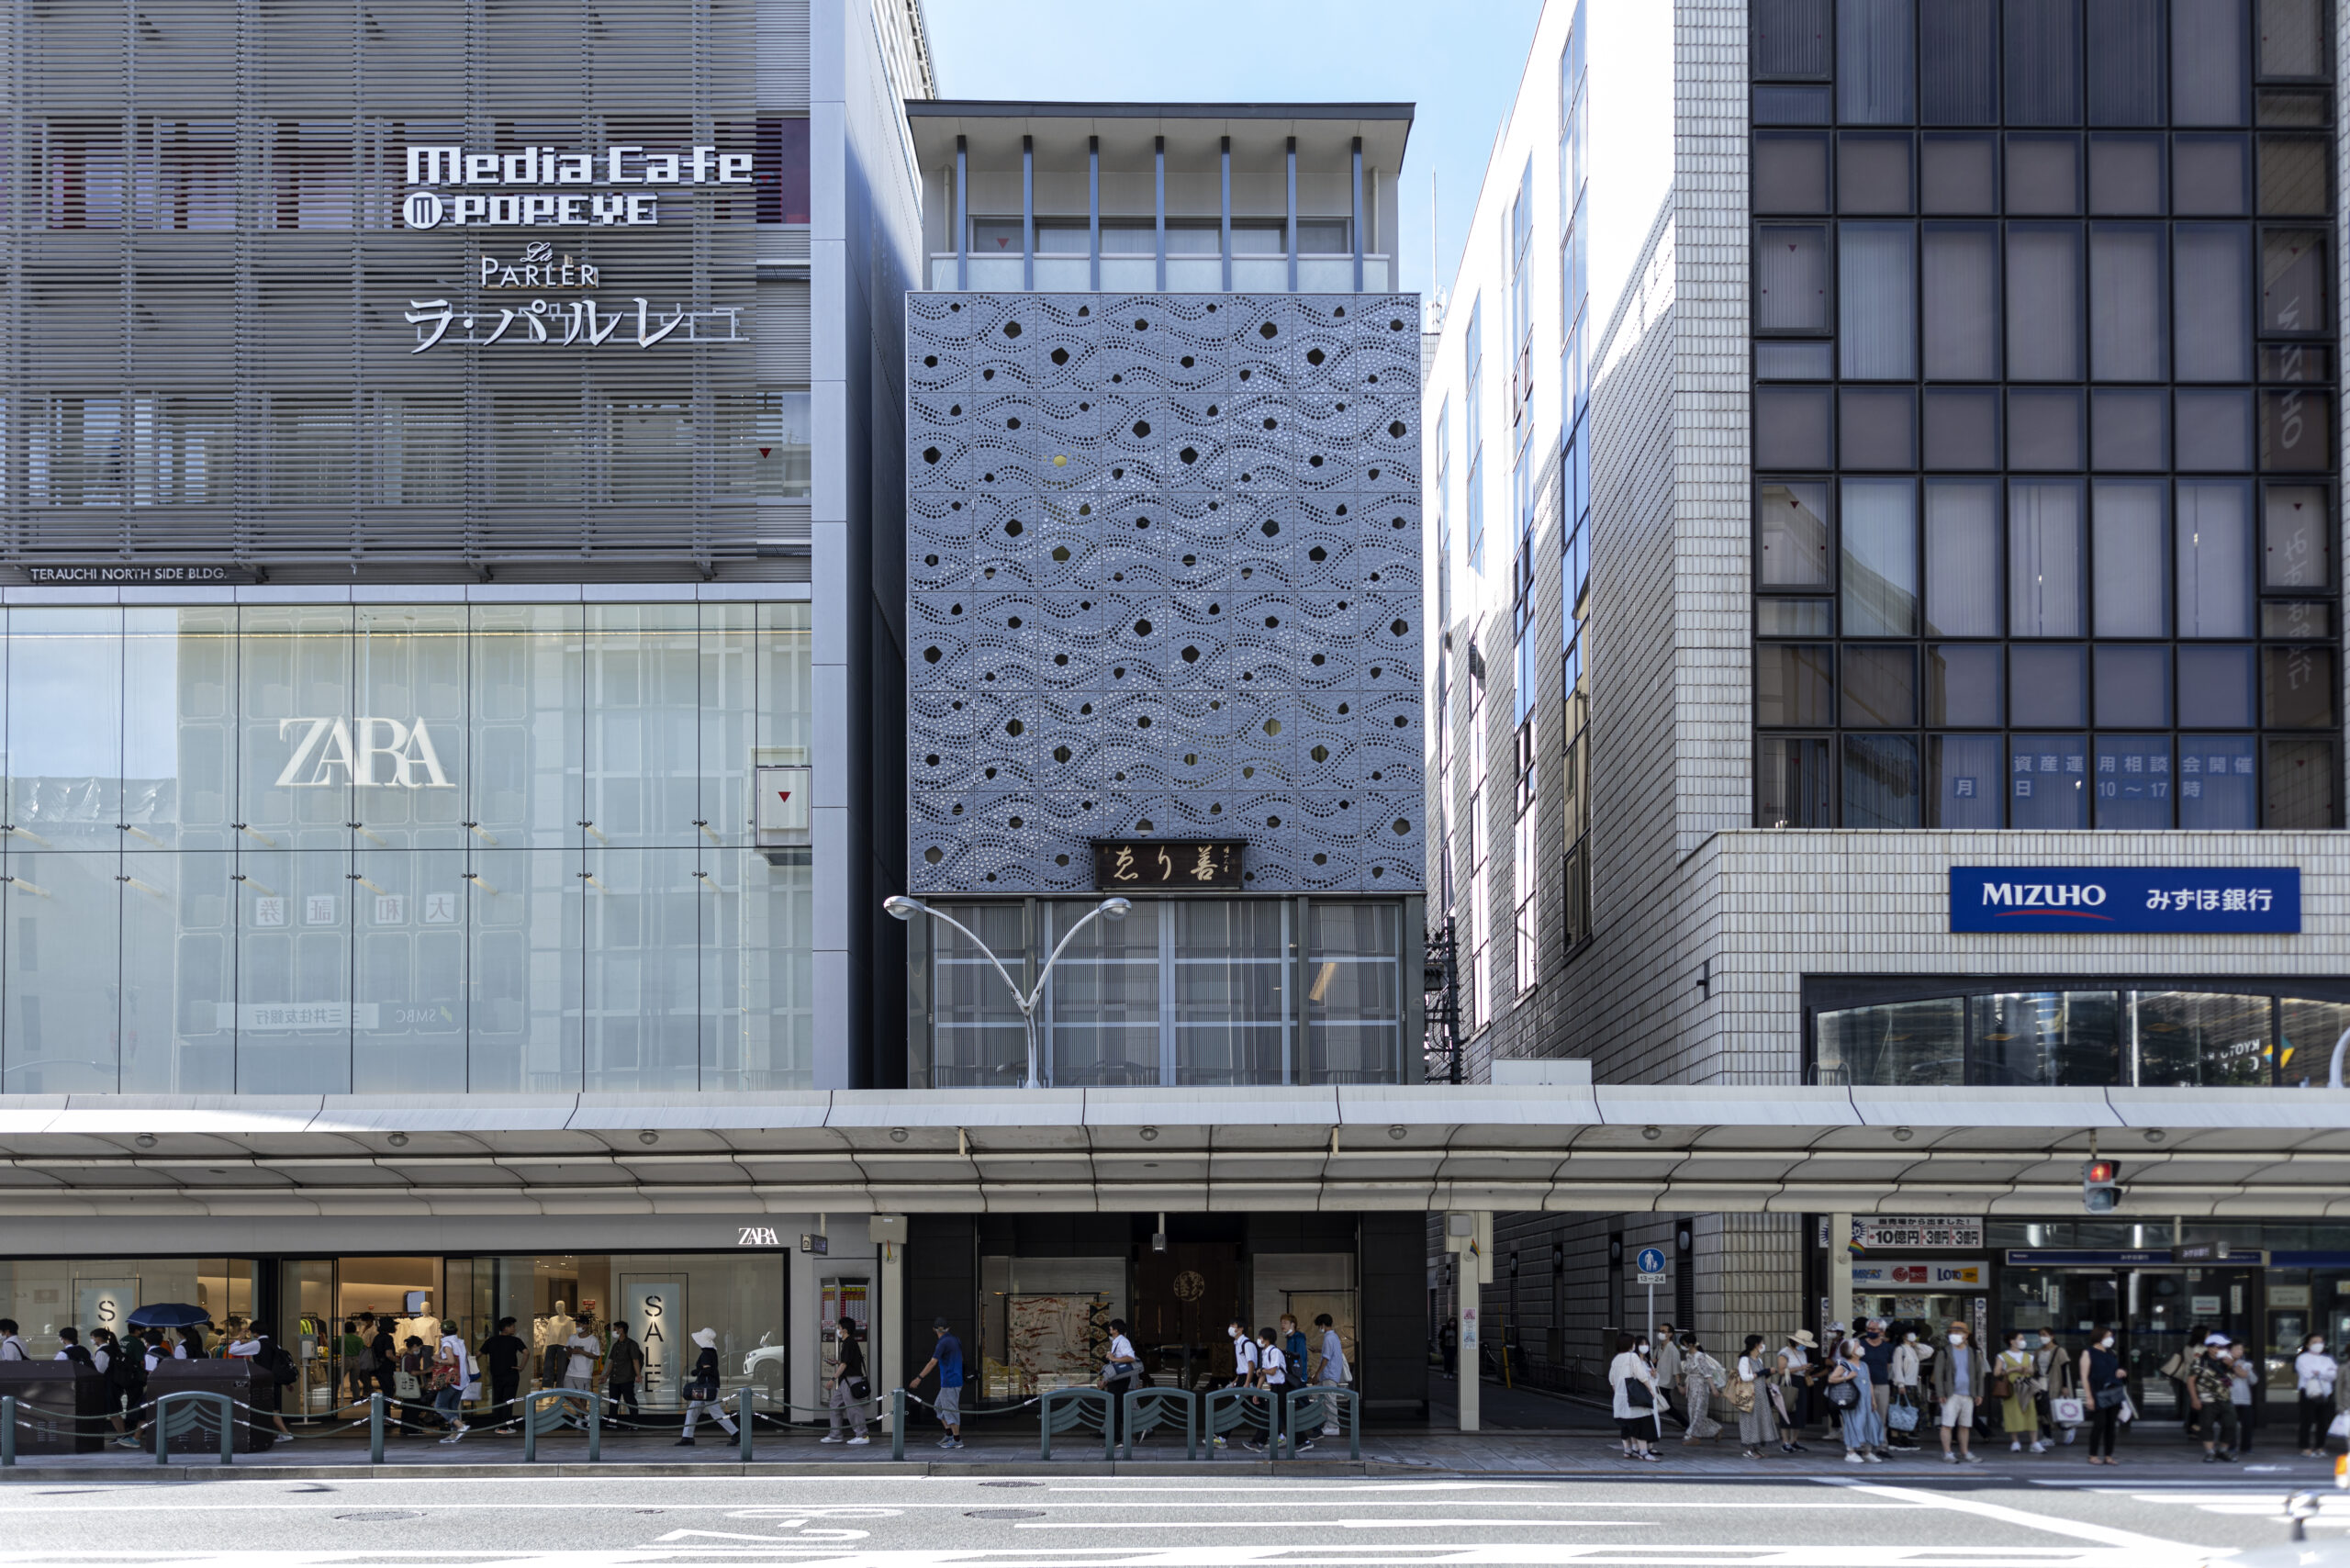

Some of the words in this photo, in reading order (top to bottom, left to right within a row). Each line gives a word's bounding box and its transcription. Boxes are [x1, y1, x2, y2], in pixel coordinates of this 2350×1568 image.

[407, 146, 593, 185] Media
[609, 146, 754, 185] Cafe
[454, 195, 658, 226] POPEYE
[520, 241, 553, 263] La
[481, 256, 597, 287] PARLER
[405, 297, 686, 355] ラ・パルレ
[30, 567, 97, 580] TERAUCHI
[102, 567, 151, 580] NORTH
[154, 567, 184, 580] SIDE
[188, 567, 228, 580] BLDG.
[274, 715, 458, 790] ZARA
[2014, 756, 2254, 774] 資産運用相談会開催
[1956, 779, 1973, 796] 月
[2016, 780, 2031, 796] 日
[1982, 882, 2107, 906] MIZUHO
[2145, 889, 2273, 912] みずほ銀行
[738, 1227, 780, 1246] ZARA
[644, 1295, 664, 1393] SALE
